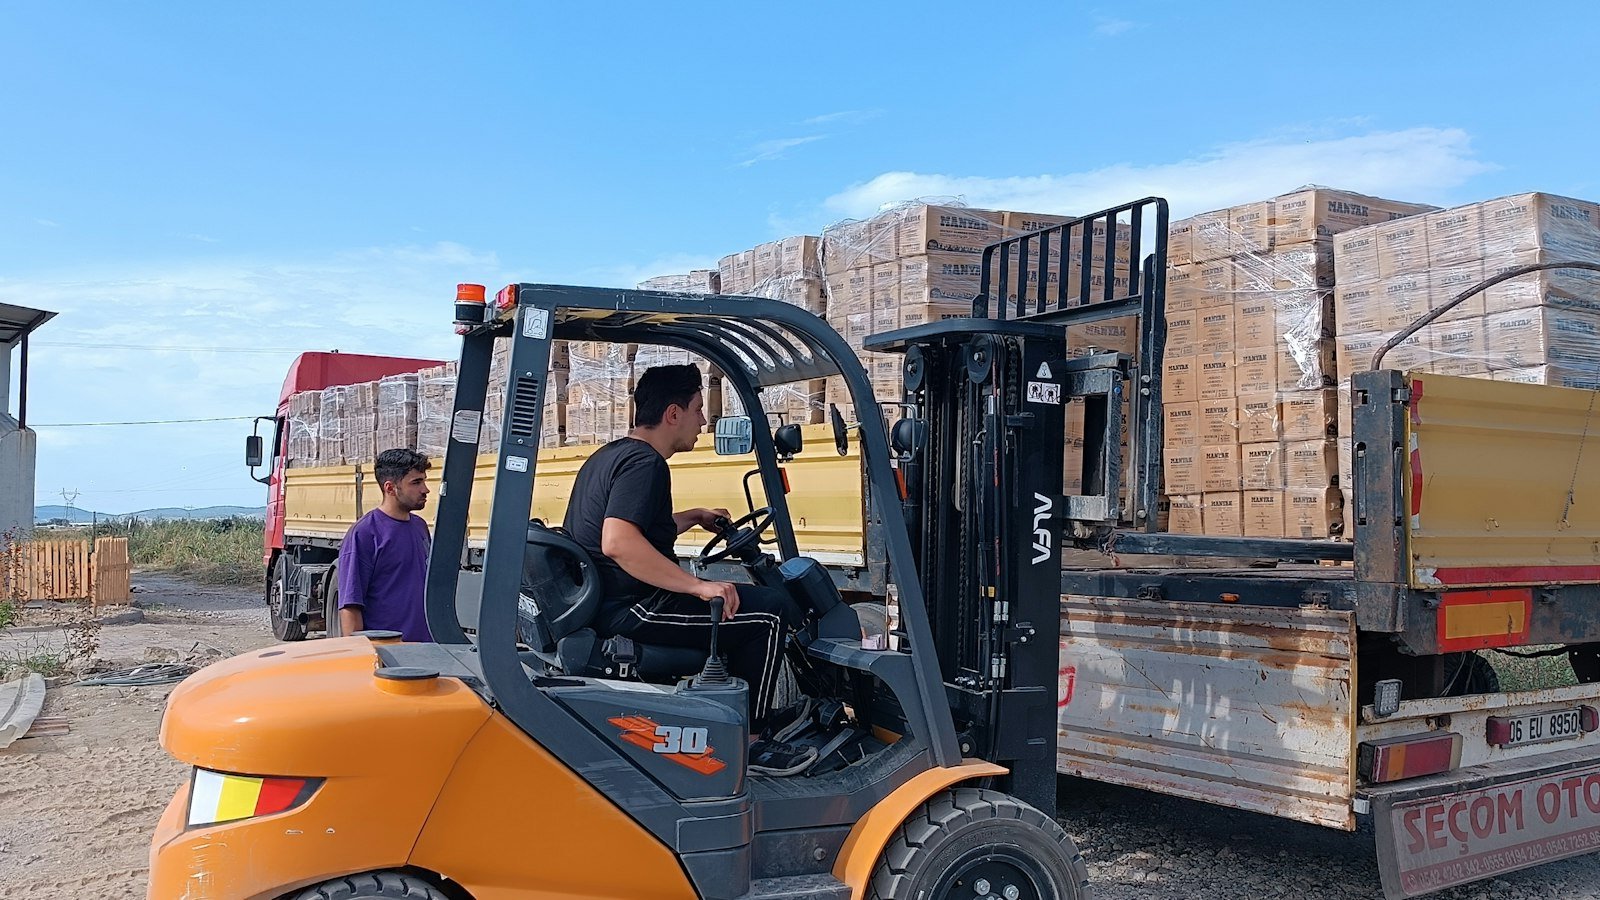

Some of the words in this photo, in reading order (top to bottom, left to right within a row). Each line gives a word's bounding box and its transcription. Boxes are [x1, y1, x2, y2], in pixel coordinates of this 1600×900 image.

[1328, 201, 1368, 217] MANYAK
[1436, 215, 1468, 228] MANYAK
[1343, 239, 1369, 250] MANYAK
[1388, 281, 1417, 293] MANYAK
[1243, 306, 1265, 314] MANYAK
[1170, 320, 1191, 328] MANYAK
[1204, 315, 1226, 323] MANYAK
[1500, 319, 1532, 329] MANYAK
[1441, 331, 1474, 342] MANYAK
[1243, 355, 1267, 363] MANYAK
[1168, 364, 1189, 372] MANYAK
[1203, 362, 1226, 370] MANYAK
[1031, 492, 1053, 565] ALFA
[1509, 720, 1522, 743] 06
[1529, 716, 1543, 740] EU
[1549, 712, 1578, 736] 8950
[653, 725, 708, 753] 30
[1404, 790, 1525, 856] SEÇOM
